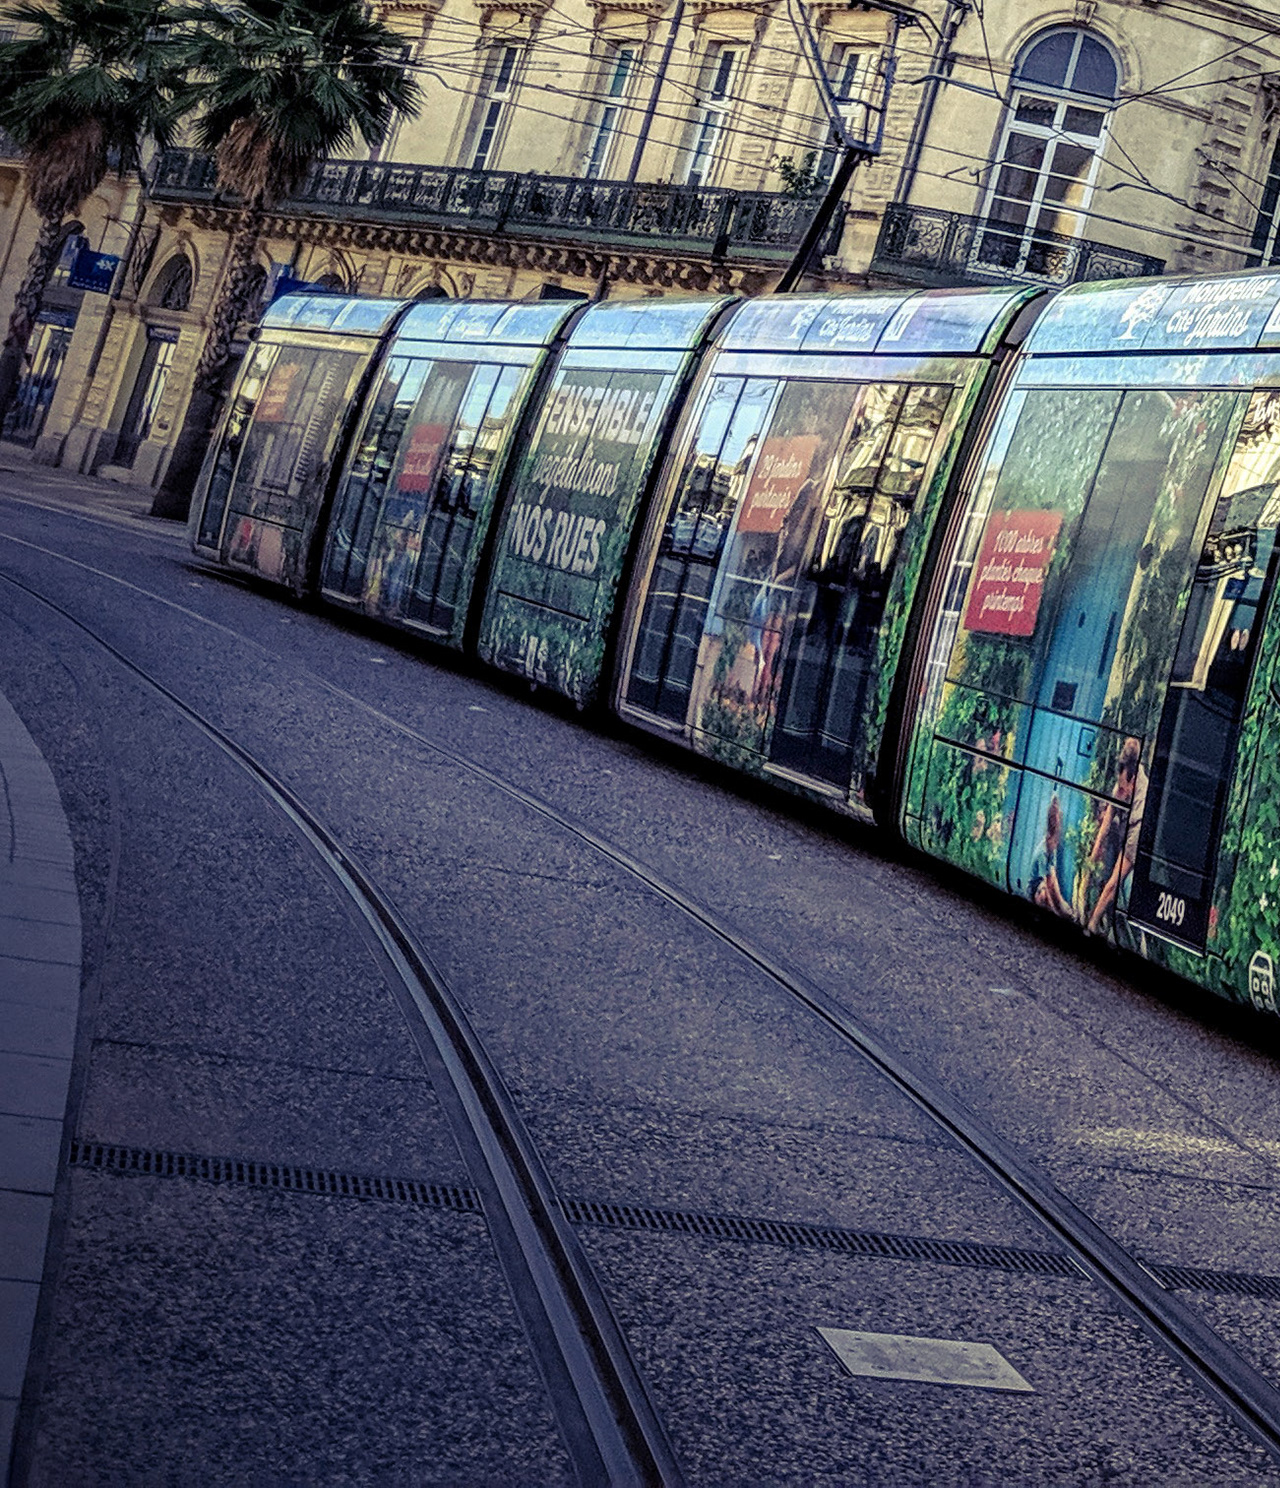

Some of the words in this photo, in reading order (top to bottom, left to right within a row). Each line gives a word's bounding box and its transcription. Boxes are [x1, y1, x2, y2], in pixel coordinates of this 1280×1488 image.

[1181, 278, 1278, 307] Montpellier
[546, 385, 654, 445] ENSEMBLE
[510, 502, 553, 562] NOS
[546, 511, 607, 575] RUES
[1156, 891, 1186, 927] 2049
